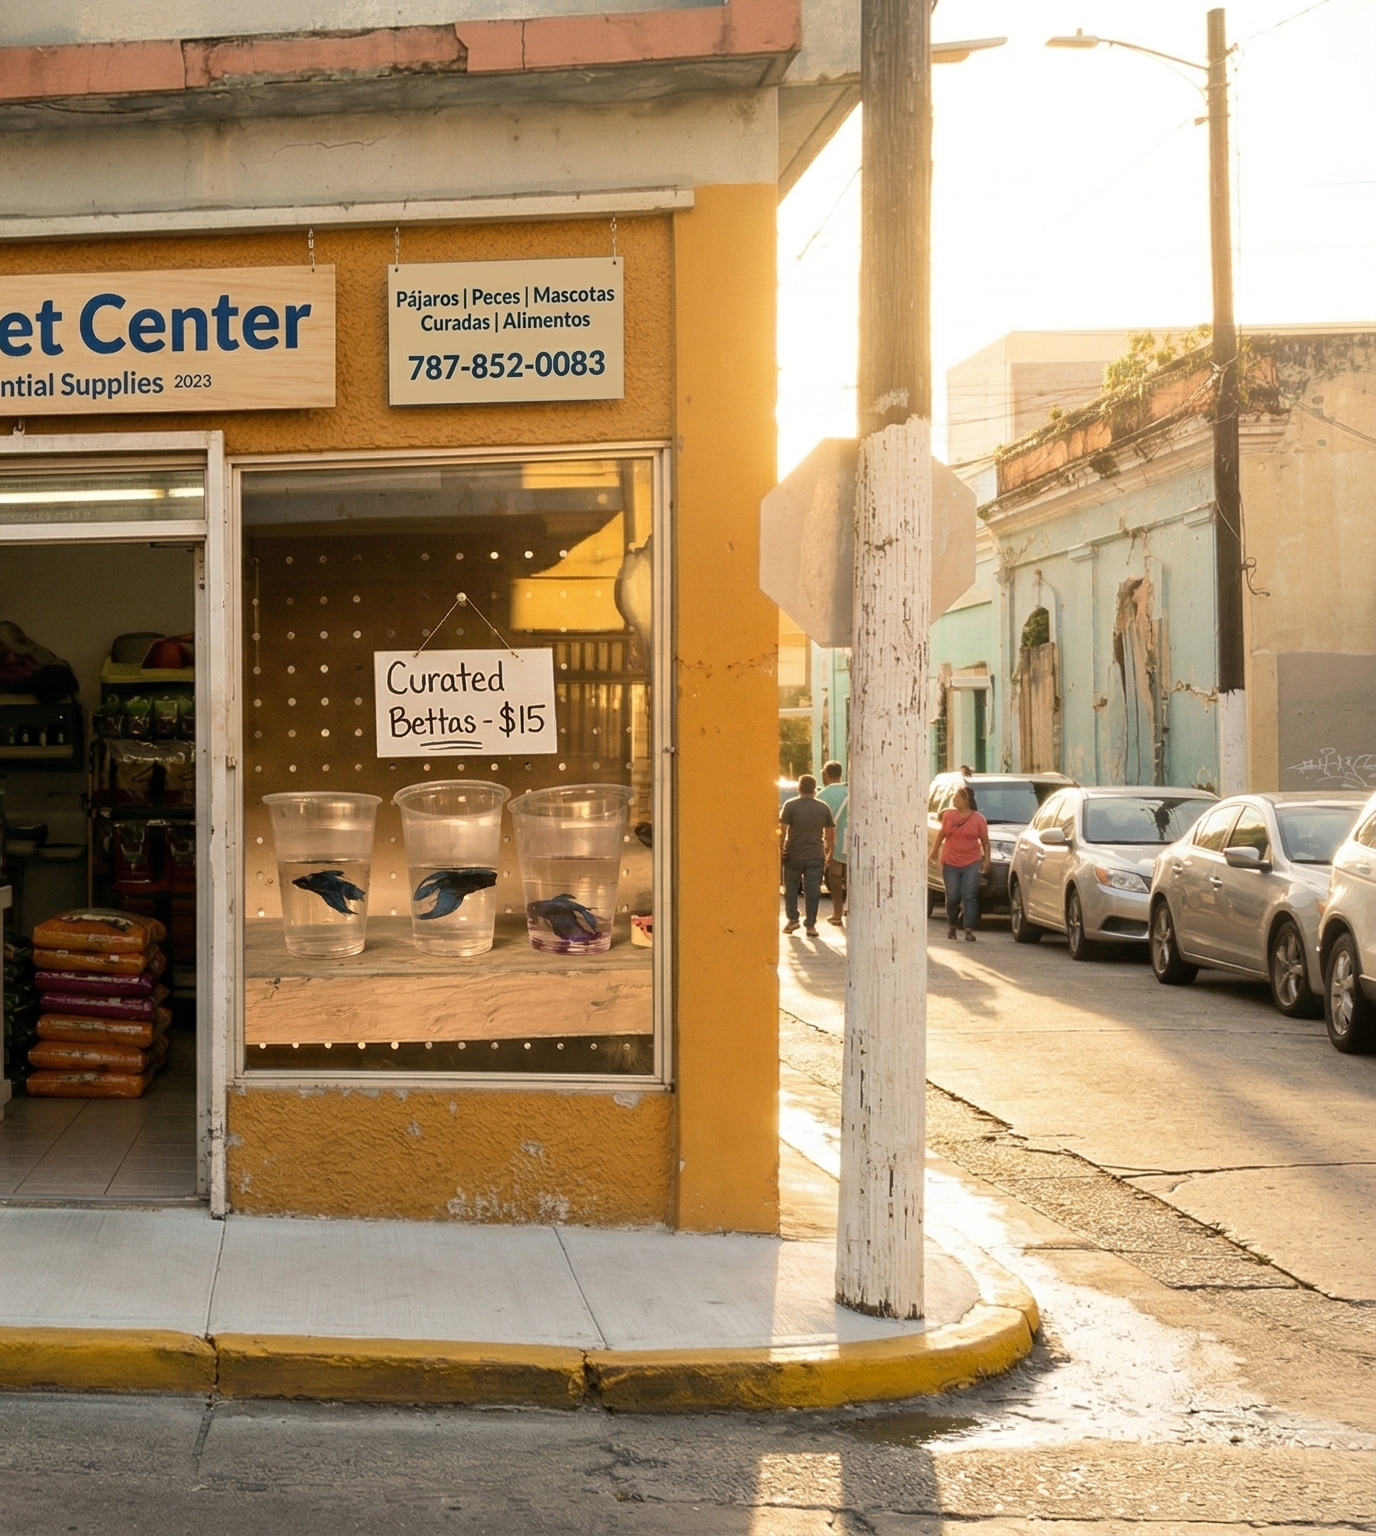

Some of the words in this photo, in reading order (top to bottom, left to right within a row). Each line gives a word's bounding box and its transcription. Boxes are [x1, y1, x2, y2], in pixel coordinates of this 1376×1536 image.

[396, 290, 459, 311] Pájaros
[472, 288, 521, 306] Peces
[533, 285, 615, 304] Mascotas
[79, 292, 312, 355] Center
[420, 313, 491, 332] Curadas
[502, 311, 591, 330] Alimentos
[408, 349, 606, 381] 787-852-0083
[60, 370, 165, 400] Supplies
[174, 374, 212, 389] 2023
[386, 660, 505, 695] Curated
[388, 705, 477, 738] Bettas
